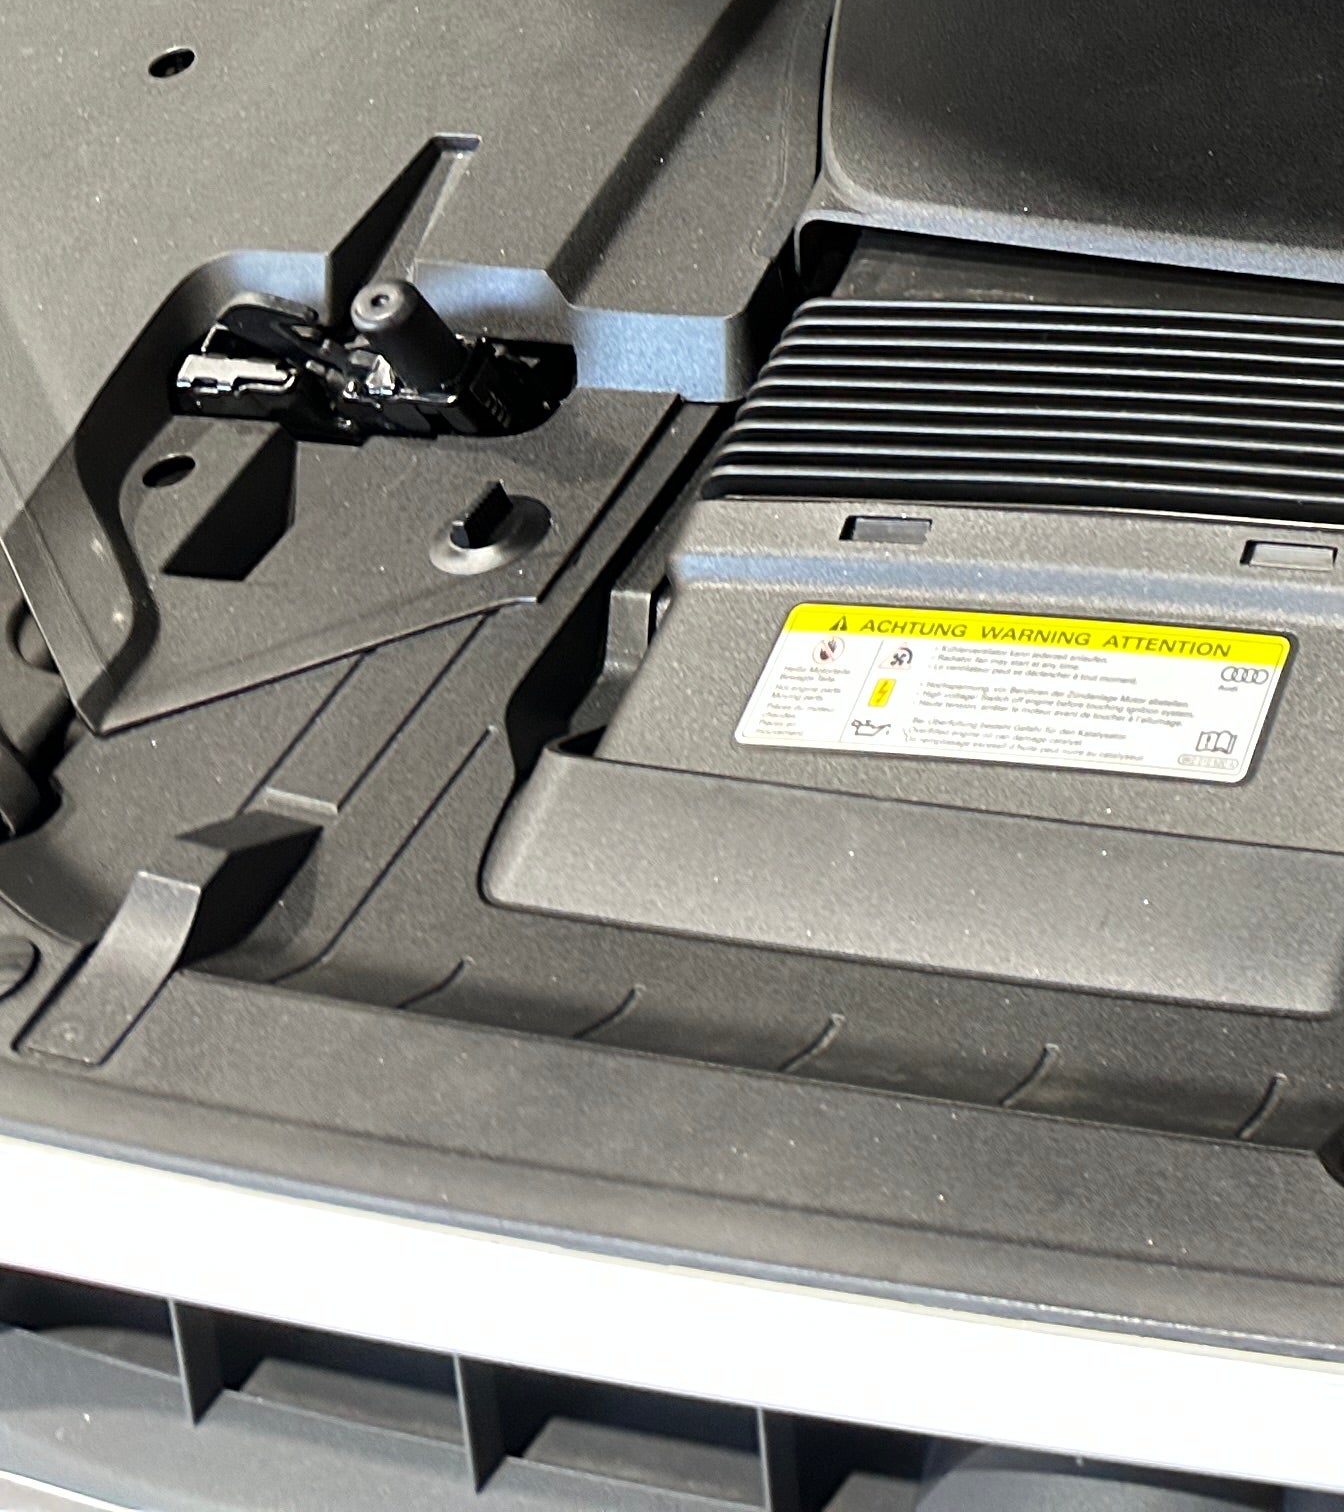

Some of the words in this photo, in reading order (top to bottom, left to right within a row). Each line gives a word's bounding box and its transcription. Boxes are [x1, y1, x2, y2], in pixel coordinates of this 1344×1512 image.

[859, 619, 968, 639] ACHTUNG
[981, 626, 1092, 647] WARNING
[1102, 635, 1231, 658] ATTENTION
